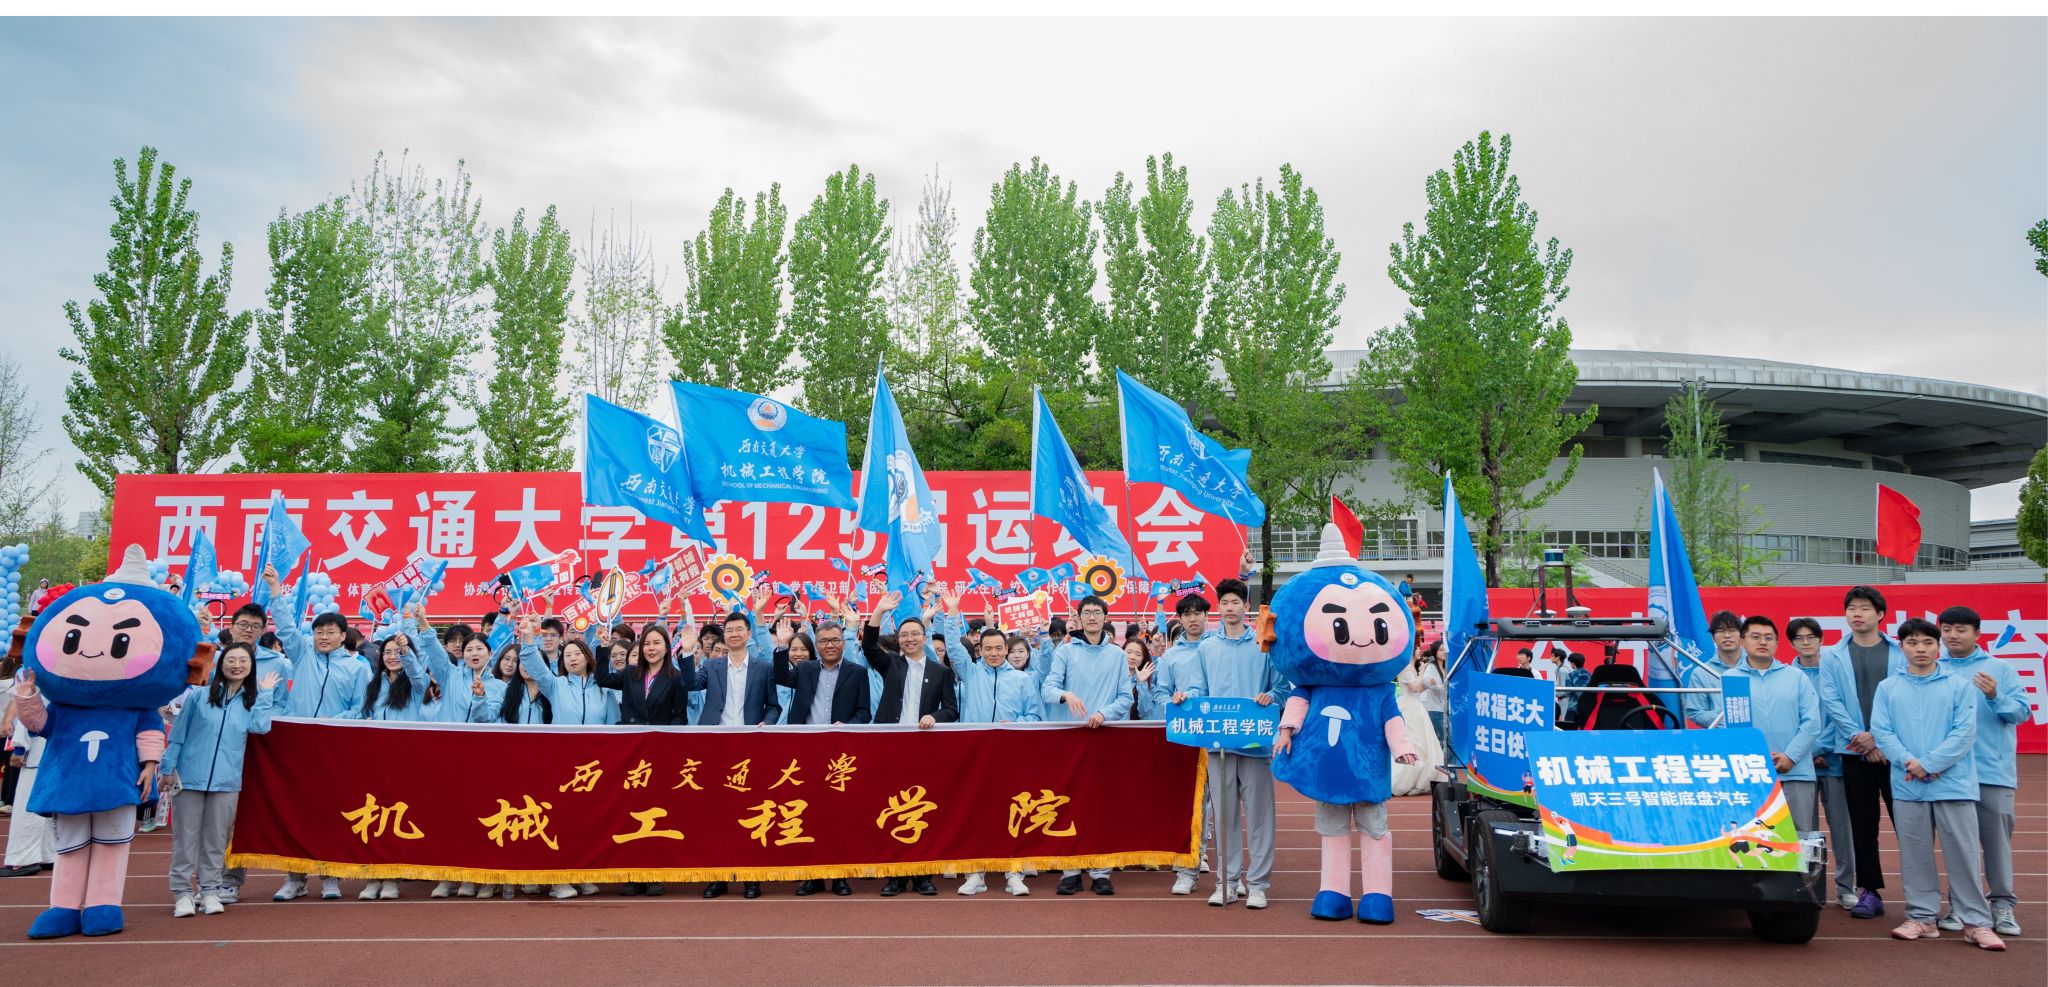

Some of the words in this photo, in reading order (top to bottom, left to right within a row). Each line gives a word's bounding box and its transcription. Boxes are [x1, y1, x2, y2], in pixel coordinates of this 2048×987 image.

[720, 461, 830, 486] 机械工程学院
[721, 480, 746, 489] SCHOOL
[746, 482, 754, 490] OF
[754, 482, 793, 491] MECHANICAL
[1203, 490, 1235, 507] University
[1475, 690, 1545, 728] 祝福交大
[1172, 717, 1275, 736] 机械工程学院
[1475, 724, 1531, 760] 生日快
[1536, 753, 1774, 787] 机械工程学院
[1569, 790, 1752, 807] 凯天三号智能底盘汽车
[341, 785, 1077, 850] 机械工程学院
